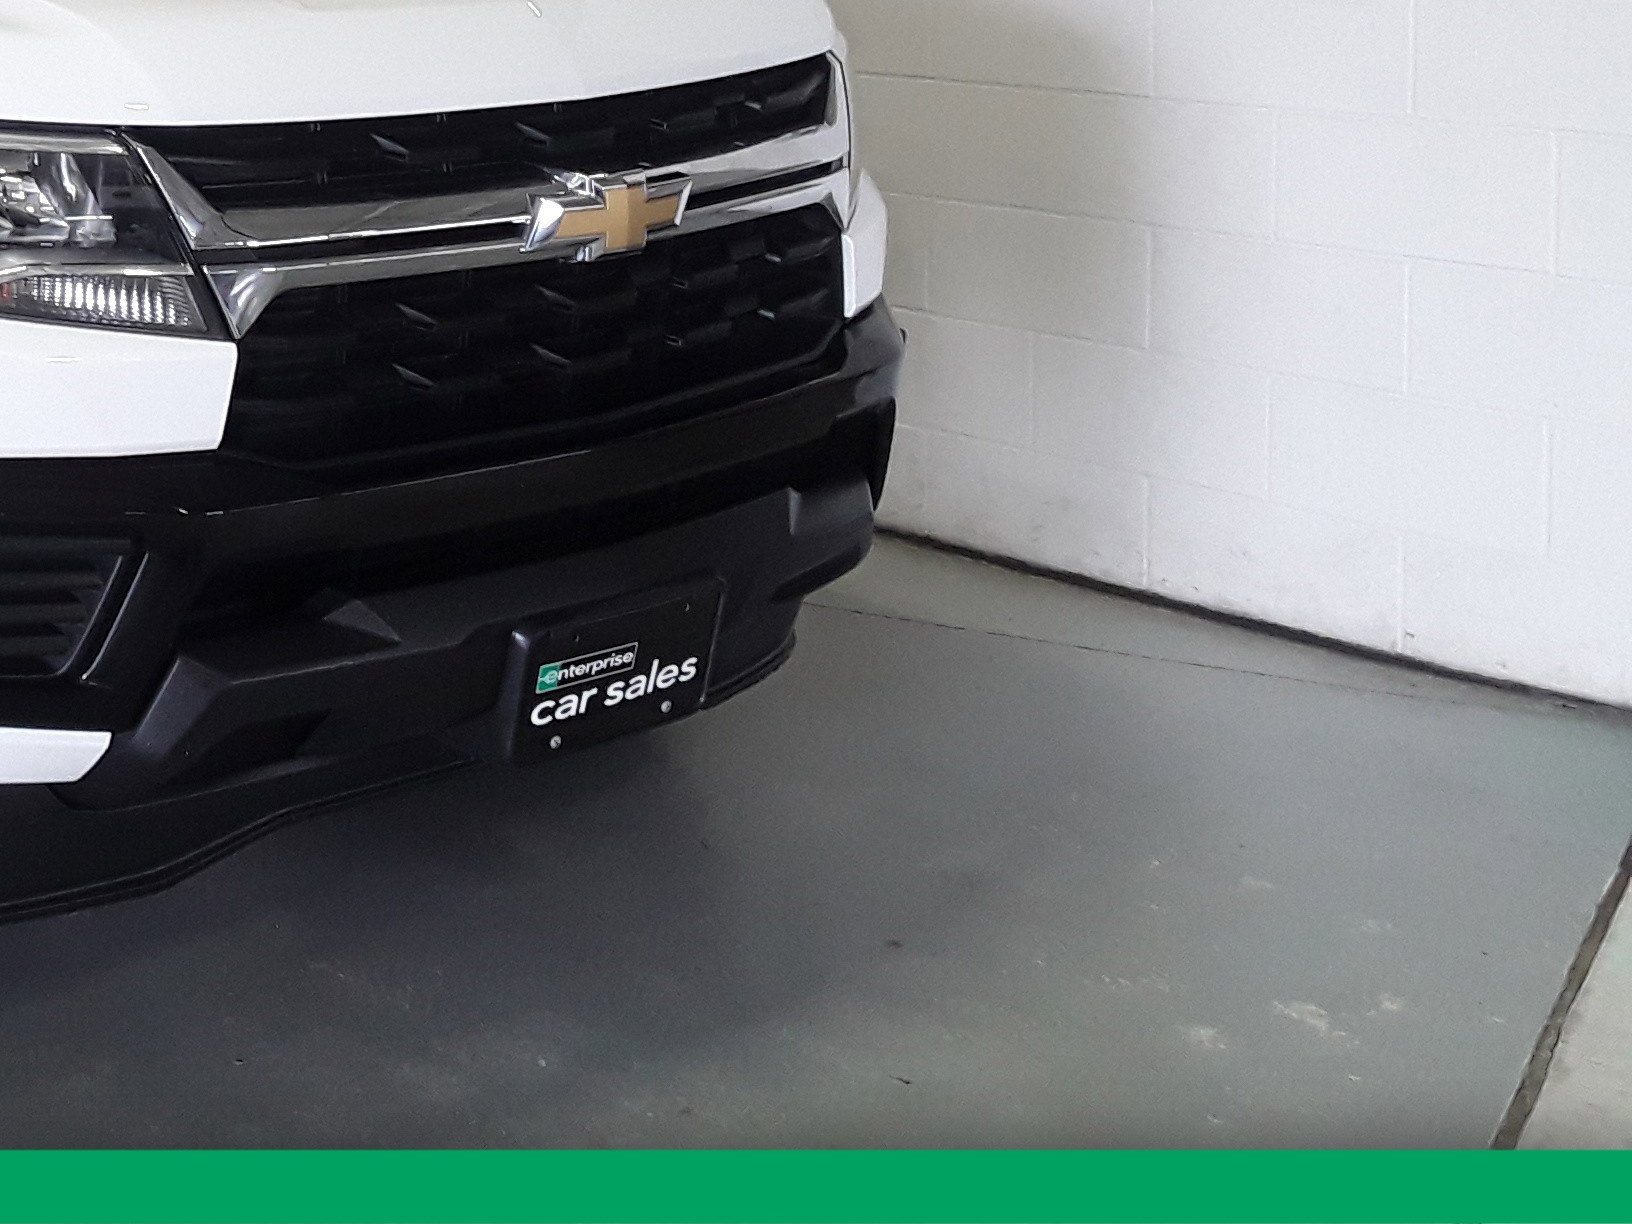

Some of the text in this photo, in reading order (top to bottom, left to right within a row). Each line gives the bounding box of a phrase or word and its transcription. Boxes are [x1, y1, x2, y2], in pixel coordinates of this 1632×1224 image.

[530, 656, 698, 726] car sales
[545, 650, 635, 685] enterprise
